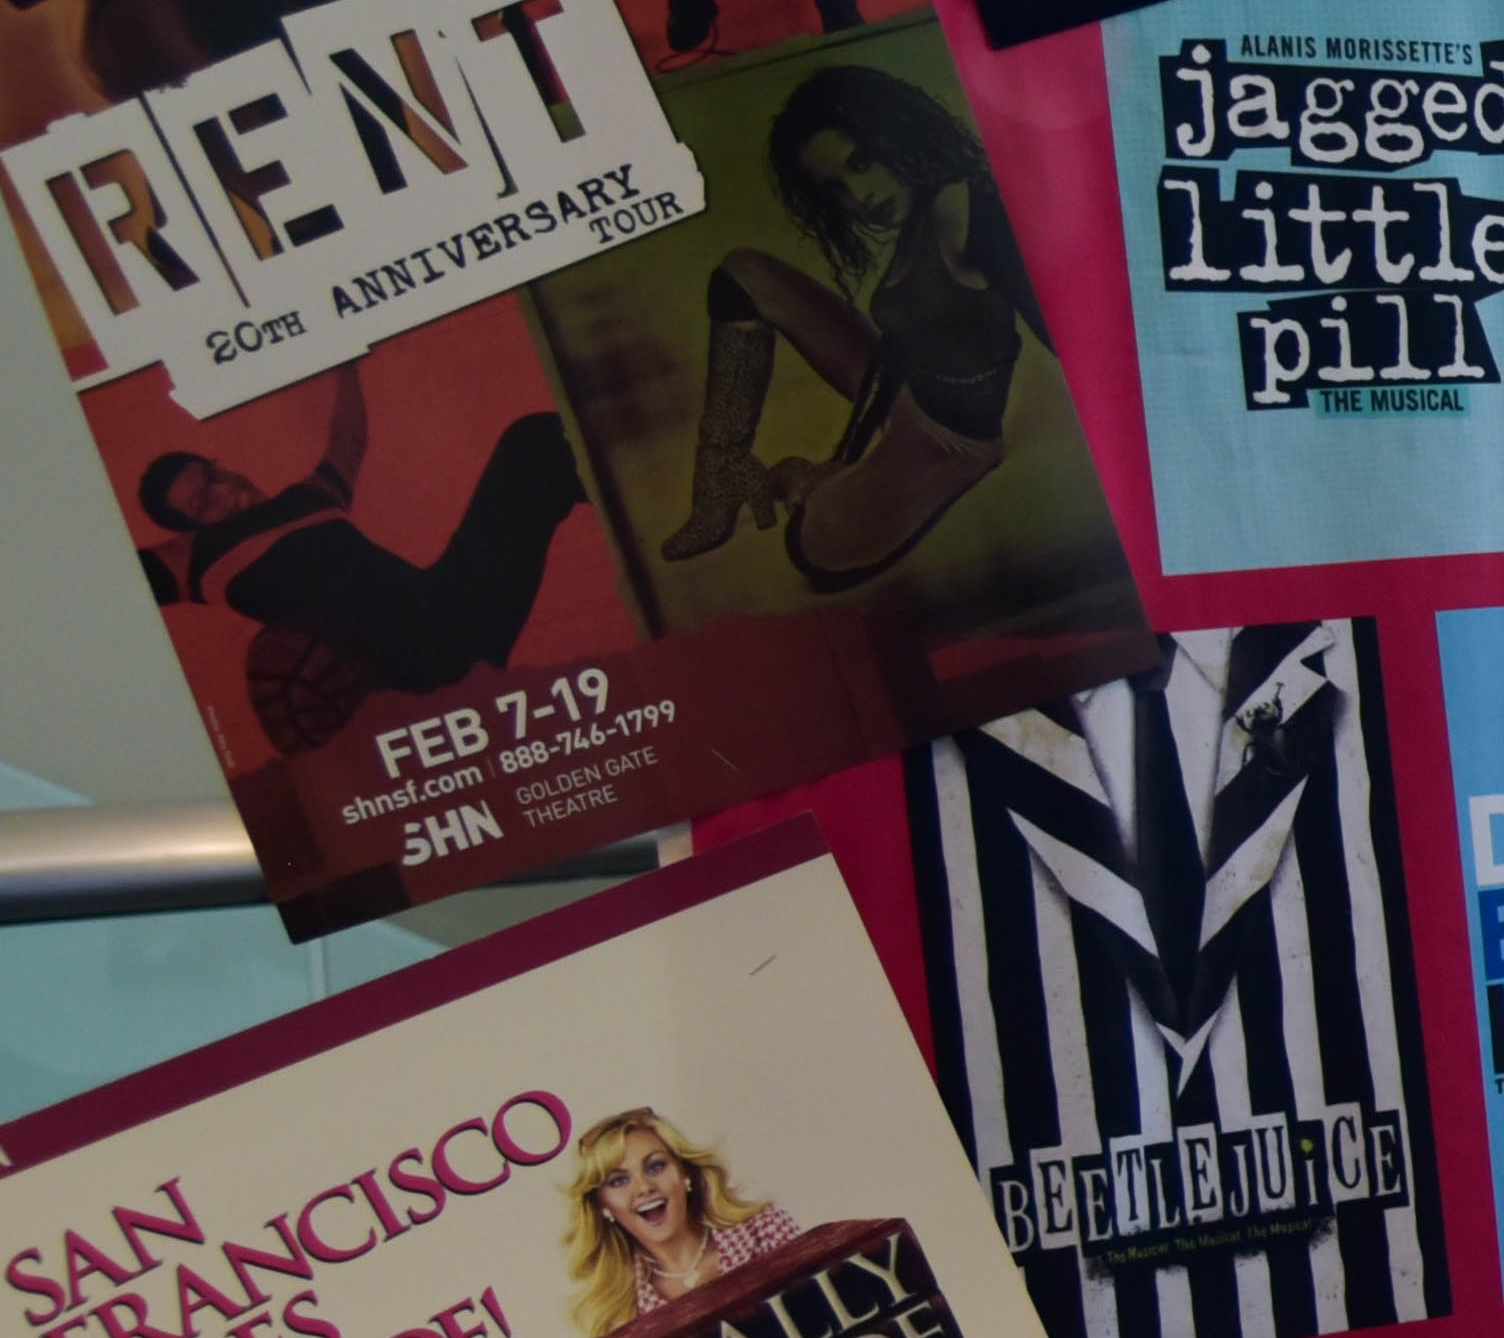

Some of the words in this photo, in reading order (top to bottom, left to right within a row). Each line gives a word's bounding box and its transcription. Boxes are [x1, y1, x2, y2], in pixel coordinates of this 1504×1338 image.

[1241, 34, 1317, 60] ALANIS
[1326, 38, 1474, 65] MORISSETTE'S
[588, 192, 685, 245] TOUR
[206, 312, 308, 366] 20TH
[333, 163, 643, 318] ANNIVERSARY
[1249, 294, 1486, 403] pill
[1319, 390, 1362, 413] THE
[1370, 389, 1464, 413] MUSICAL
[375, 707, 490, 779] FEB
[496, 667, 613, 739] 7-19
[341, 761, 484, 827] shnsf.com
[500, 700, 677, 773] 888-746-1799
[515, 766, 601, 806] GOLDEN
[603, 748, 658, 779] GATE
[401, 800, 503, 866] SHN
[522, 785, 619, 827] THEATRE
[3, 1179, 206, 1329] SAN
